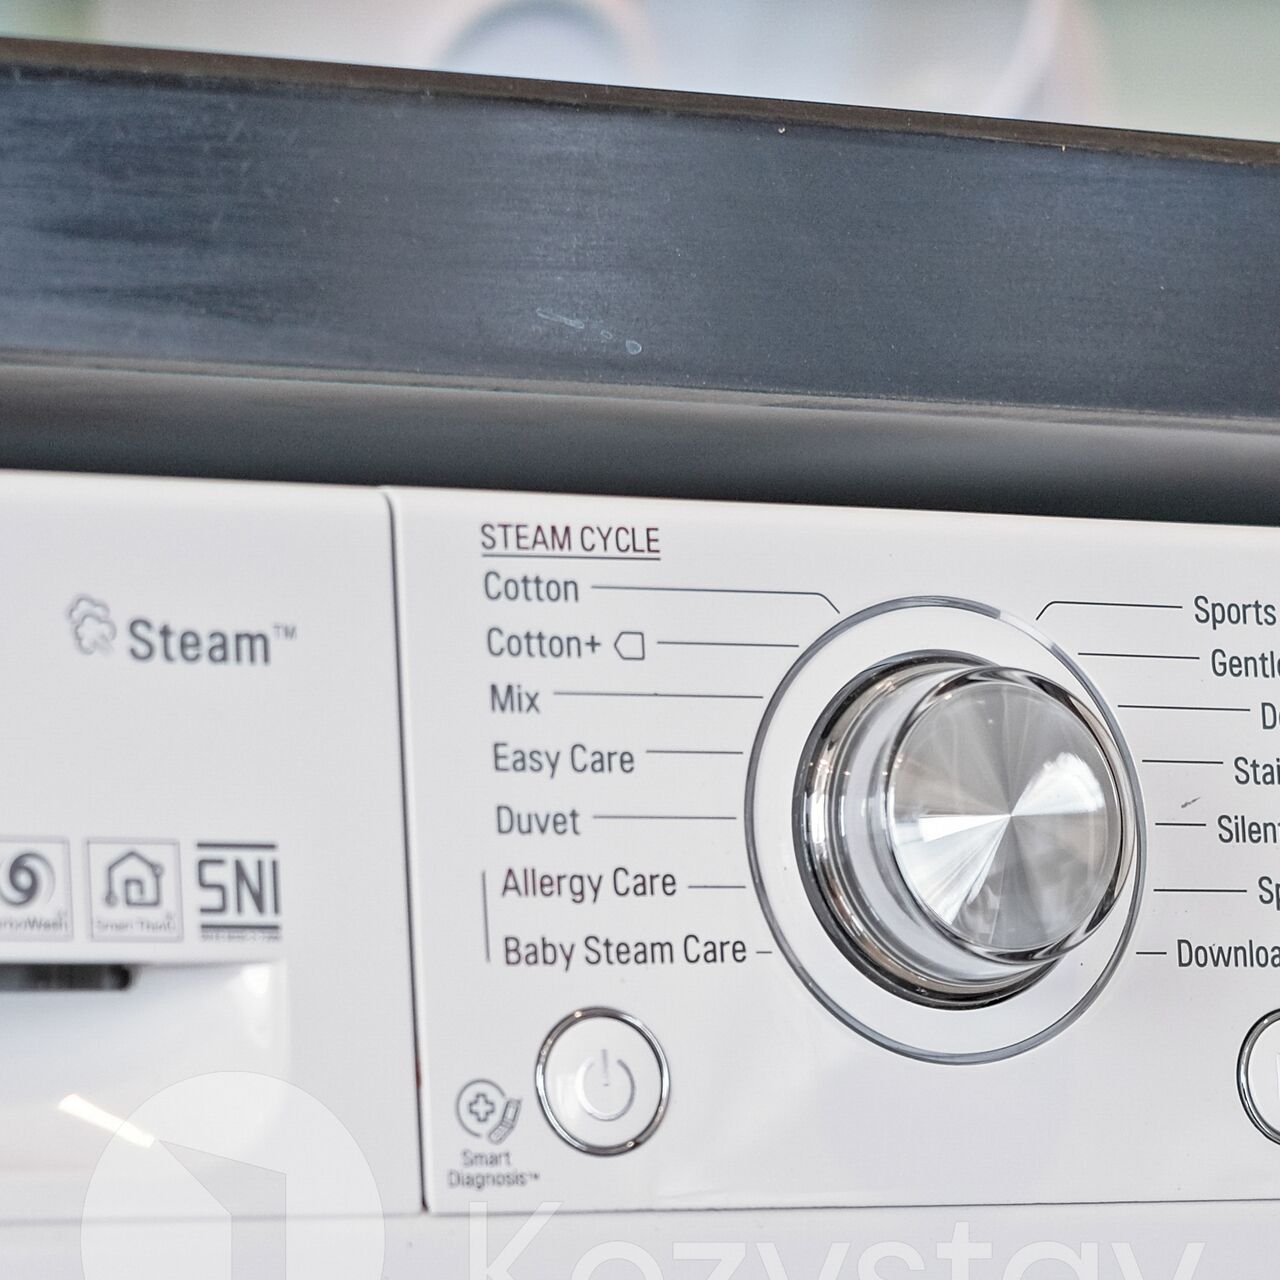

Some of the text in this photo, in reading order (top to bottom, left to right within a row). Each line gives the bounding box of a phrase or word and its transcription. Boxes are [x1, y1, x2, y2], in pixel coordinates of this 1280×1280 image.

[481, 523, 661, 553] STEAM CYCLE
[483, 571, 580, 603] Cotton
[1193, 595, 1277, 630] Sports
[486, 626, 602, 659] Cotton+
[489, 684, 541, 714] Mix
[493, 743, 635, 777] Easy Care
[496, 805, 581, 836] Duvet
[197, 858, 281, 915] SNI
[502, 867, 677, 902] Allergy Care
[504, 935, 748, 971] Baby Steam Care
[463, 1149, 511, 1167] Smart
